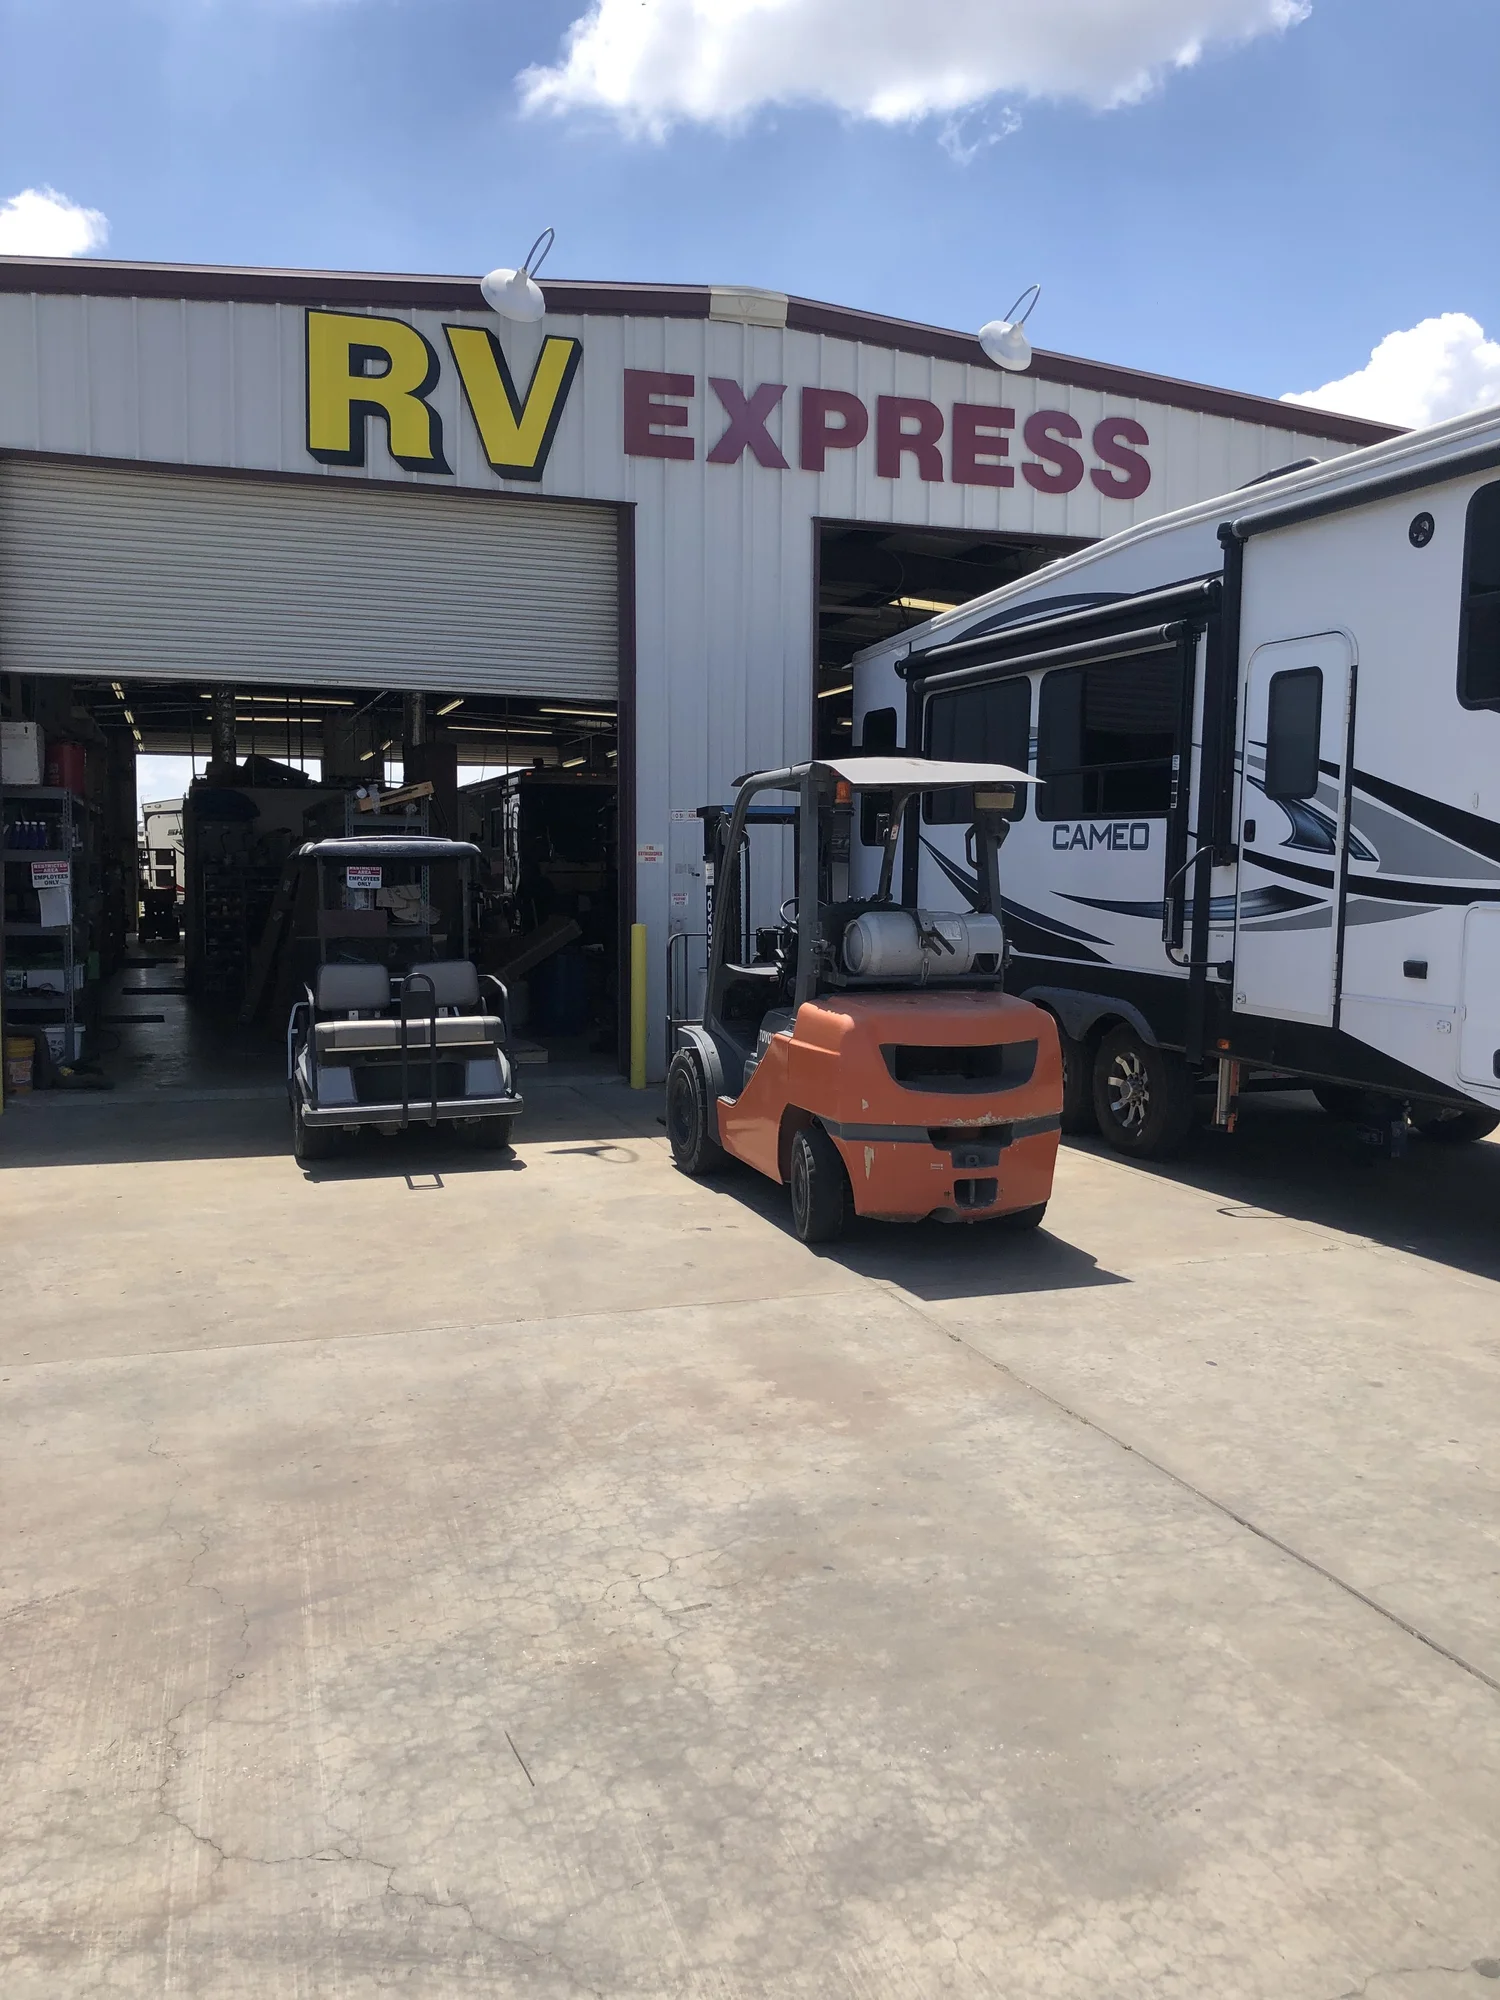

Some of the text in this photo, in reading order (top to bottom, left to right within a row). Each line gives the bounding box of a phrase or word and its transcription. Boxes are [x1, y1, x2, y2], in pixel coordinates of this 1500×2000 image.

[305, 308, 1151, 499] RV EXPRESS
[1053, 823, 1149, 850] CAMEO
